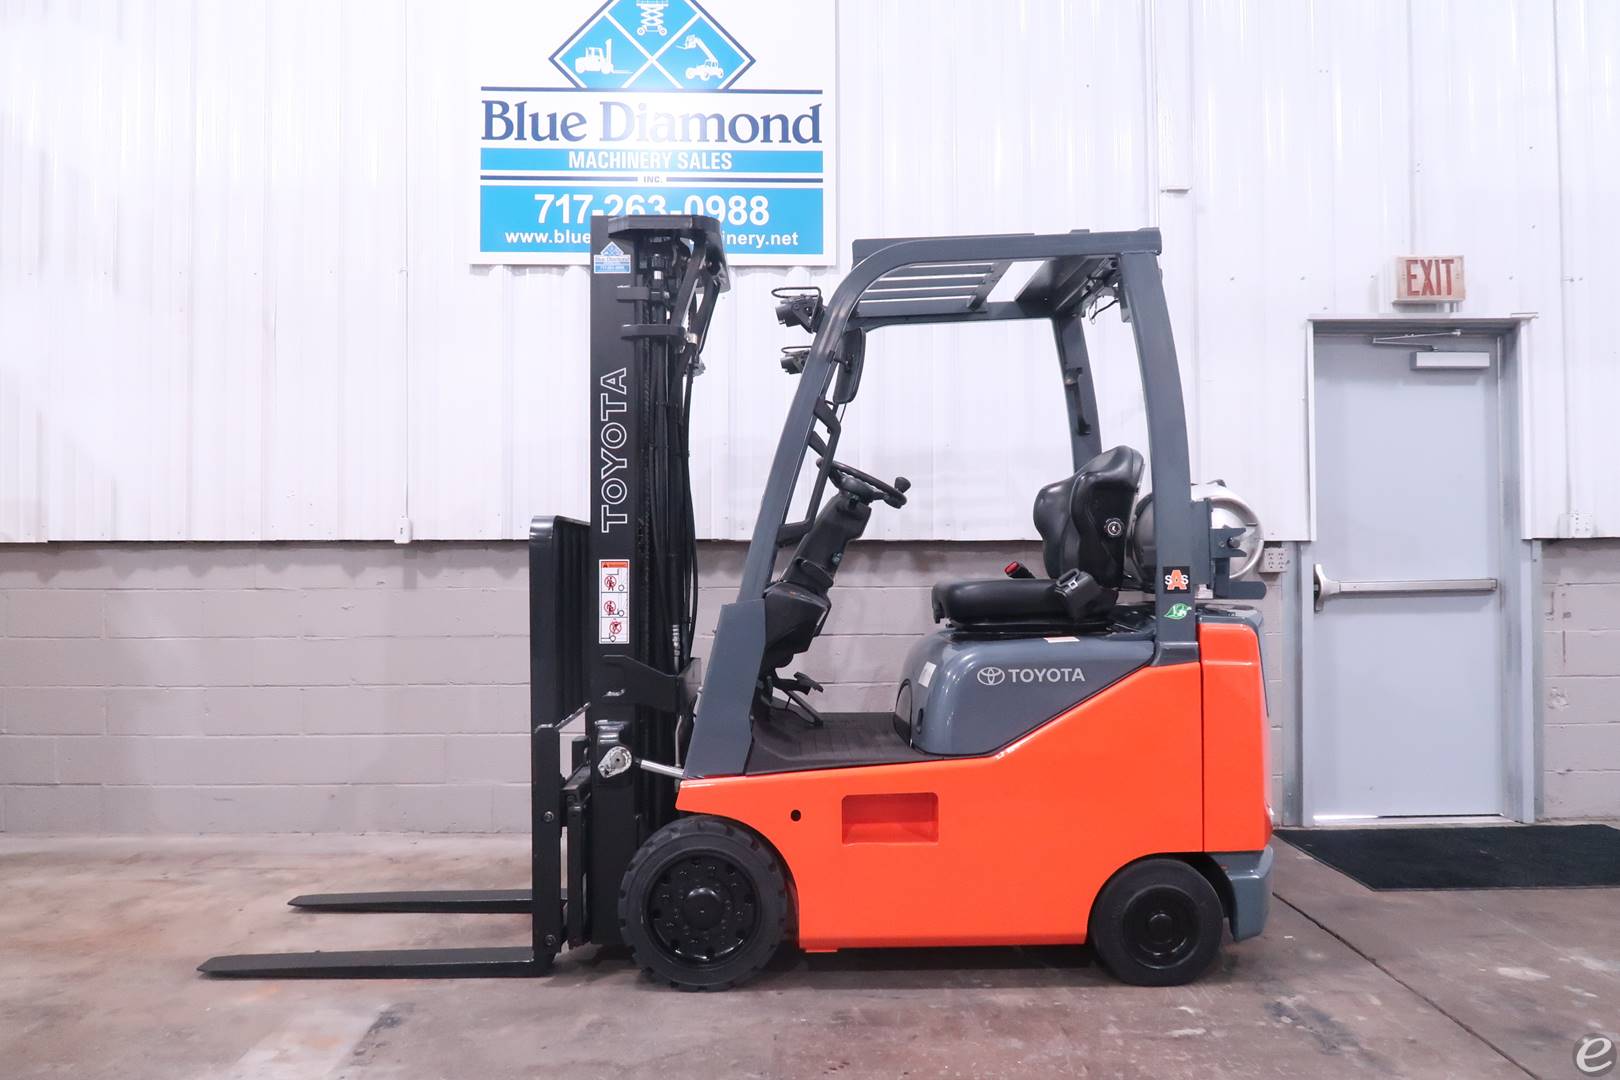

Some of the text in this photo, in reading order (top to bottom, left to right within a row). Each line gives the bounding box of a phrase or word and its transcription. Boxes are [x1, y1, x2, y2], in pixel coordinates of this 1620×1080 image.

[481, 100, 822, 144] Blue Diamond
[568, 151, 732, 170] MACHINERY SALES
[643, 176, 663, 184] INC.
[534, 193, 770, 226] 717-263-0988
[1406, 258, 1455, 297] EXIT
[600, 367, 628, 534] TOYOTA
[1164, 569, 1189, 591] SAS
[1008, 667, 1086, 683] TOYOTA
